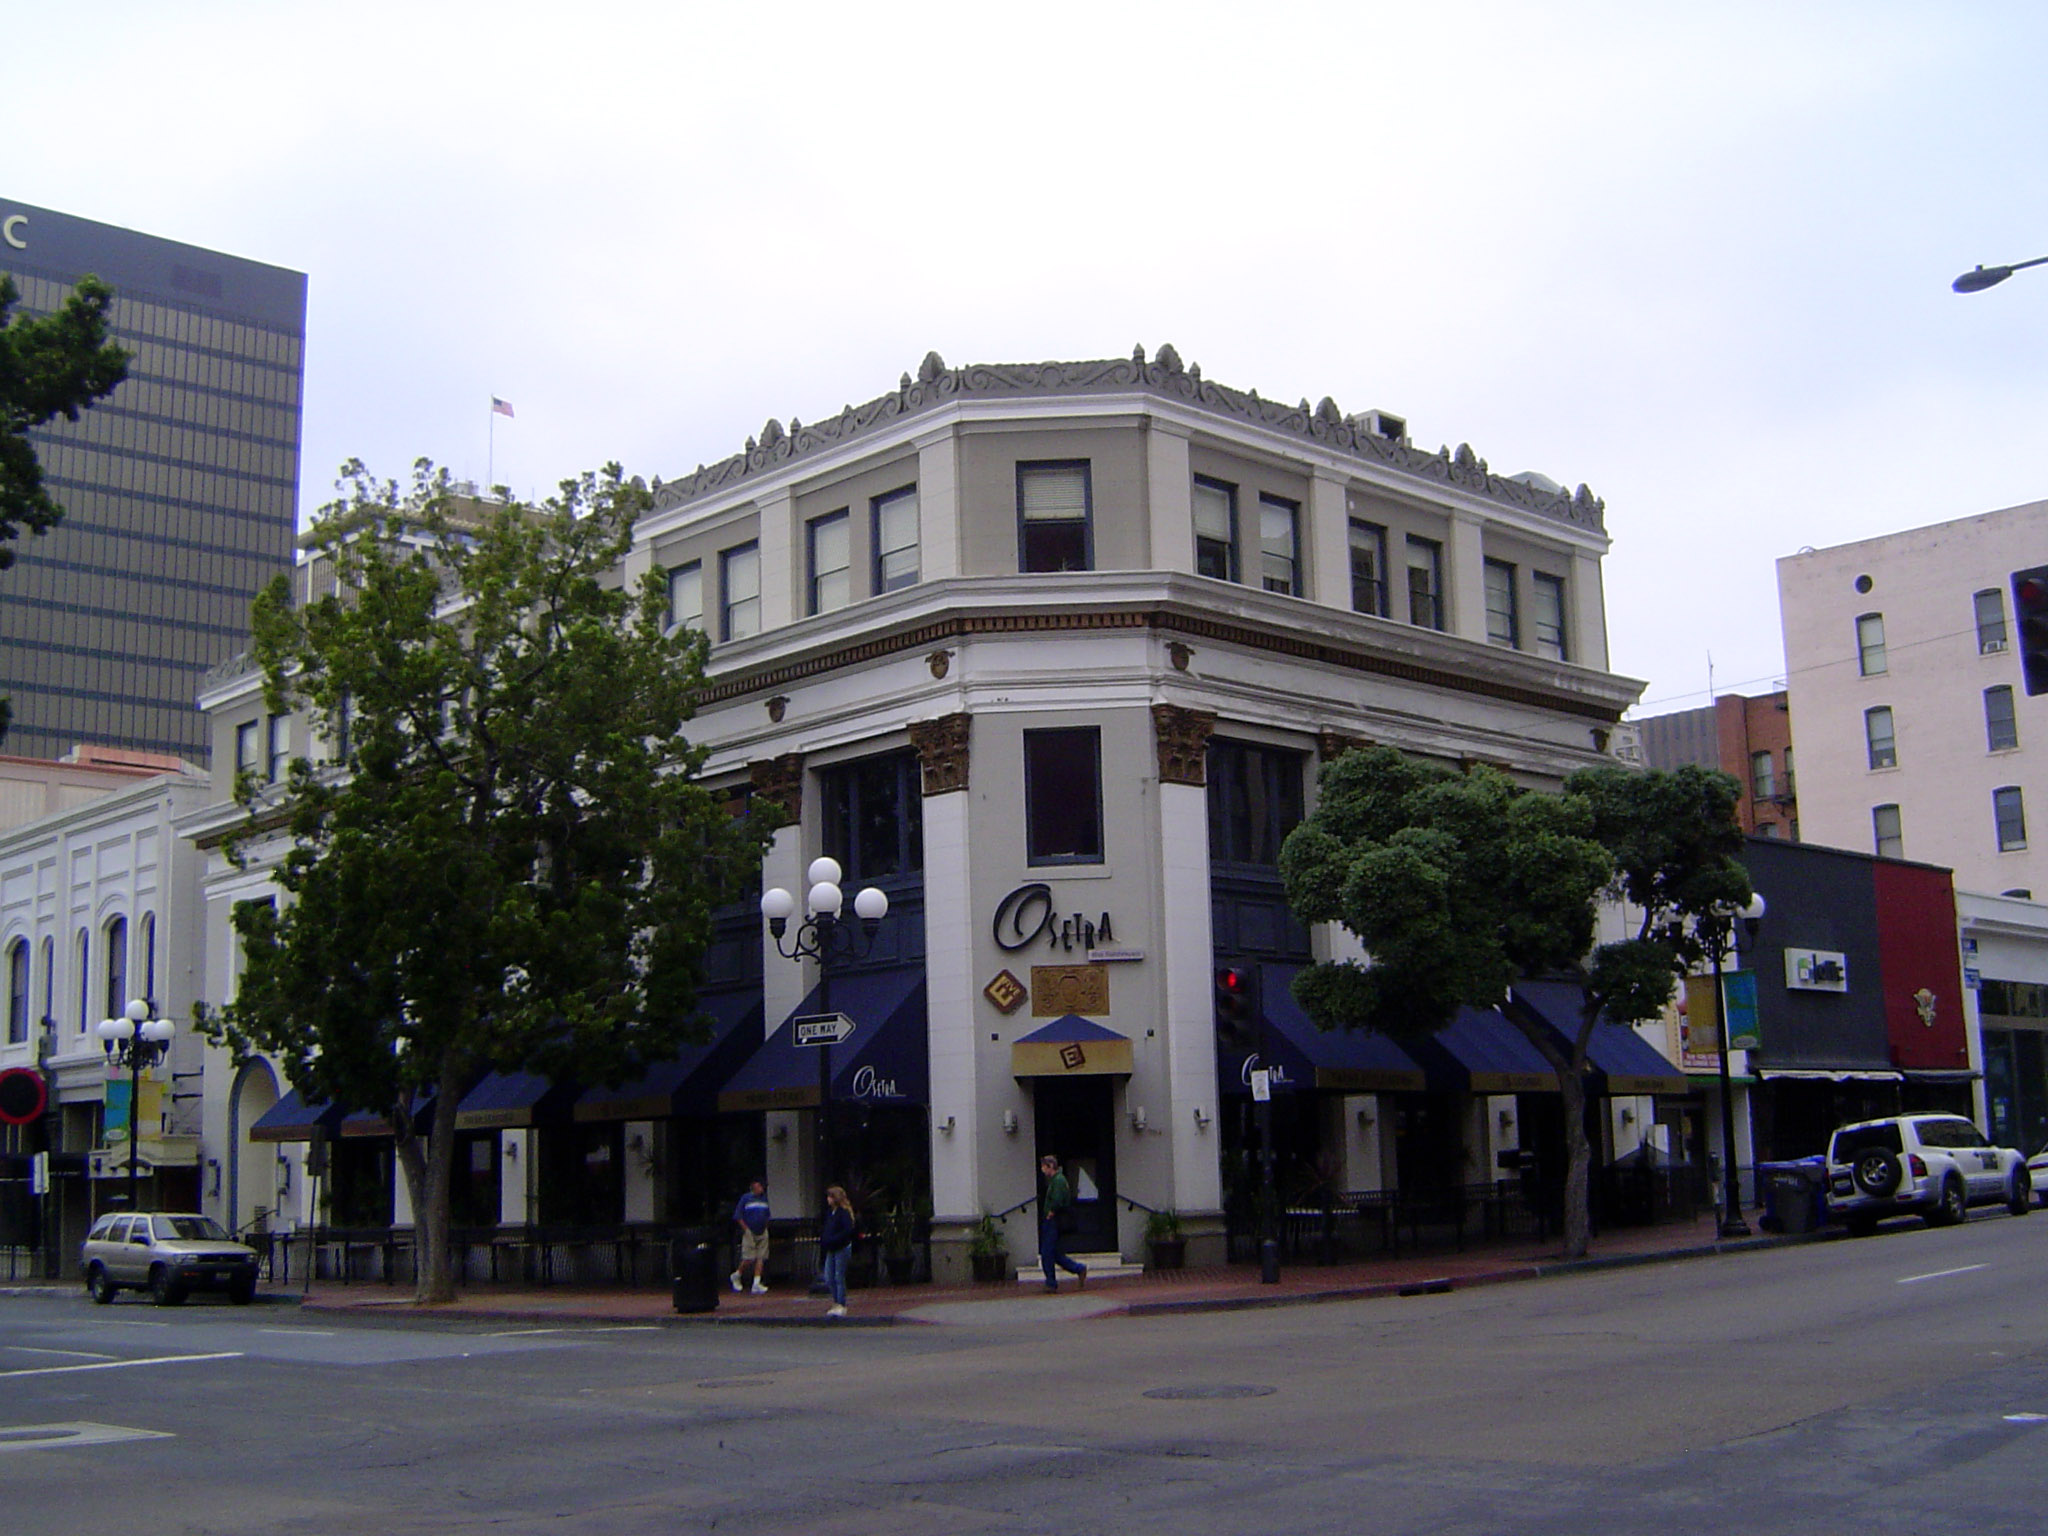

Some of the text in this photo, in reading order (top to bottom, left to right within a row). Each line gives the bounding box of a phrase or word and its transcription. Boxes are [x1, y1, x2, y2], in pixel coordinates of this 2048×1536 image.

[3, 214, 28, 249] C
[800, 1023, 838, 1037] ONE WAY
